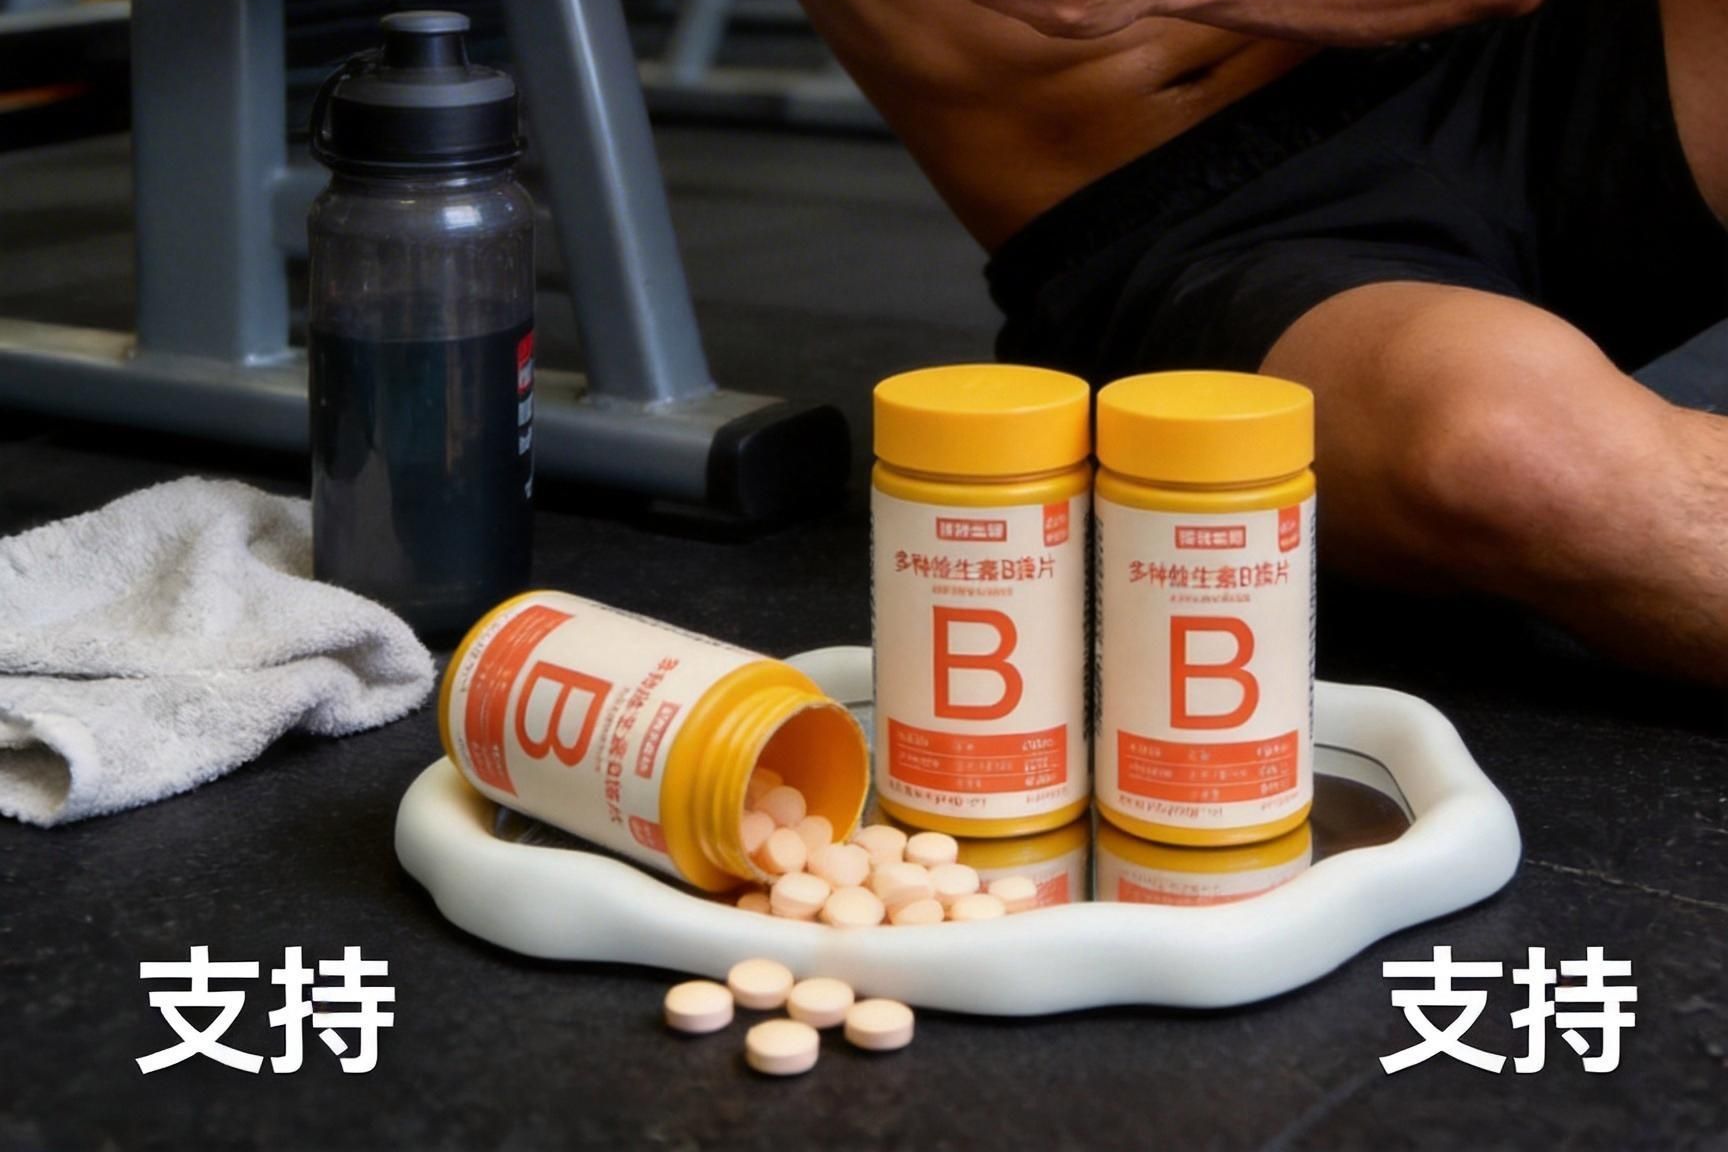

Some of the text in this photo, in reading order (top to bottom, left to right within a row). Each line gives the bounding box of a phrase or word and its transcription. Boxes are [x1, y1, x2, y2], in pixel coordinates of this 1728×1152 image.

[515, 659, 614, 768] B
[933, 605, 1024, 722] B
[1169, 615, 1260, 731] B
